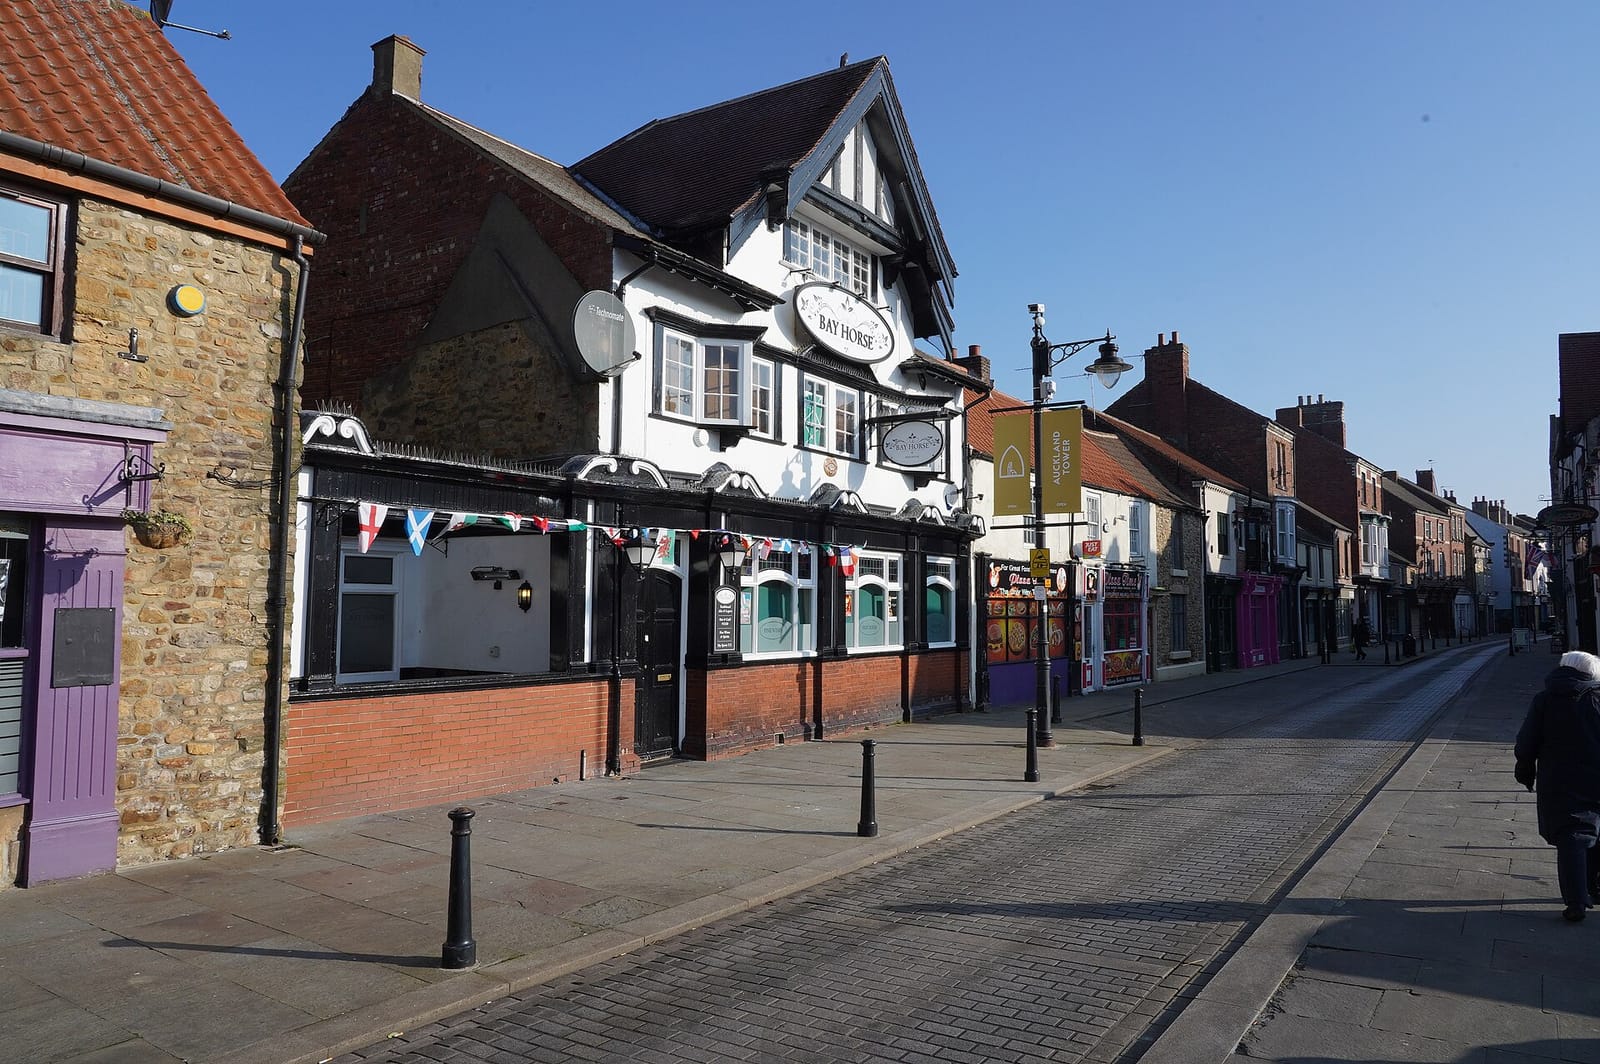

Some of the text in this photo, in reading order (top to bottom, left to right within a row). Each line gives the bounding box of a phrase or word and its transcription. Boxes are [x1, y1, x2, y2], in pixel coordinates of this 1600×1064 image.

[596, 306, 624, 322] Technomate
[819, 313, 874, 351] BAY HORSE
[1052, 431, 1061, 485] AUCKLAND
[1062, 439, 1071, 476] TOWER
[1009, 572, 1031, 586] Pizza
